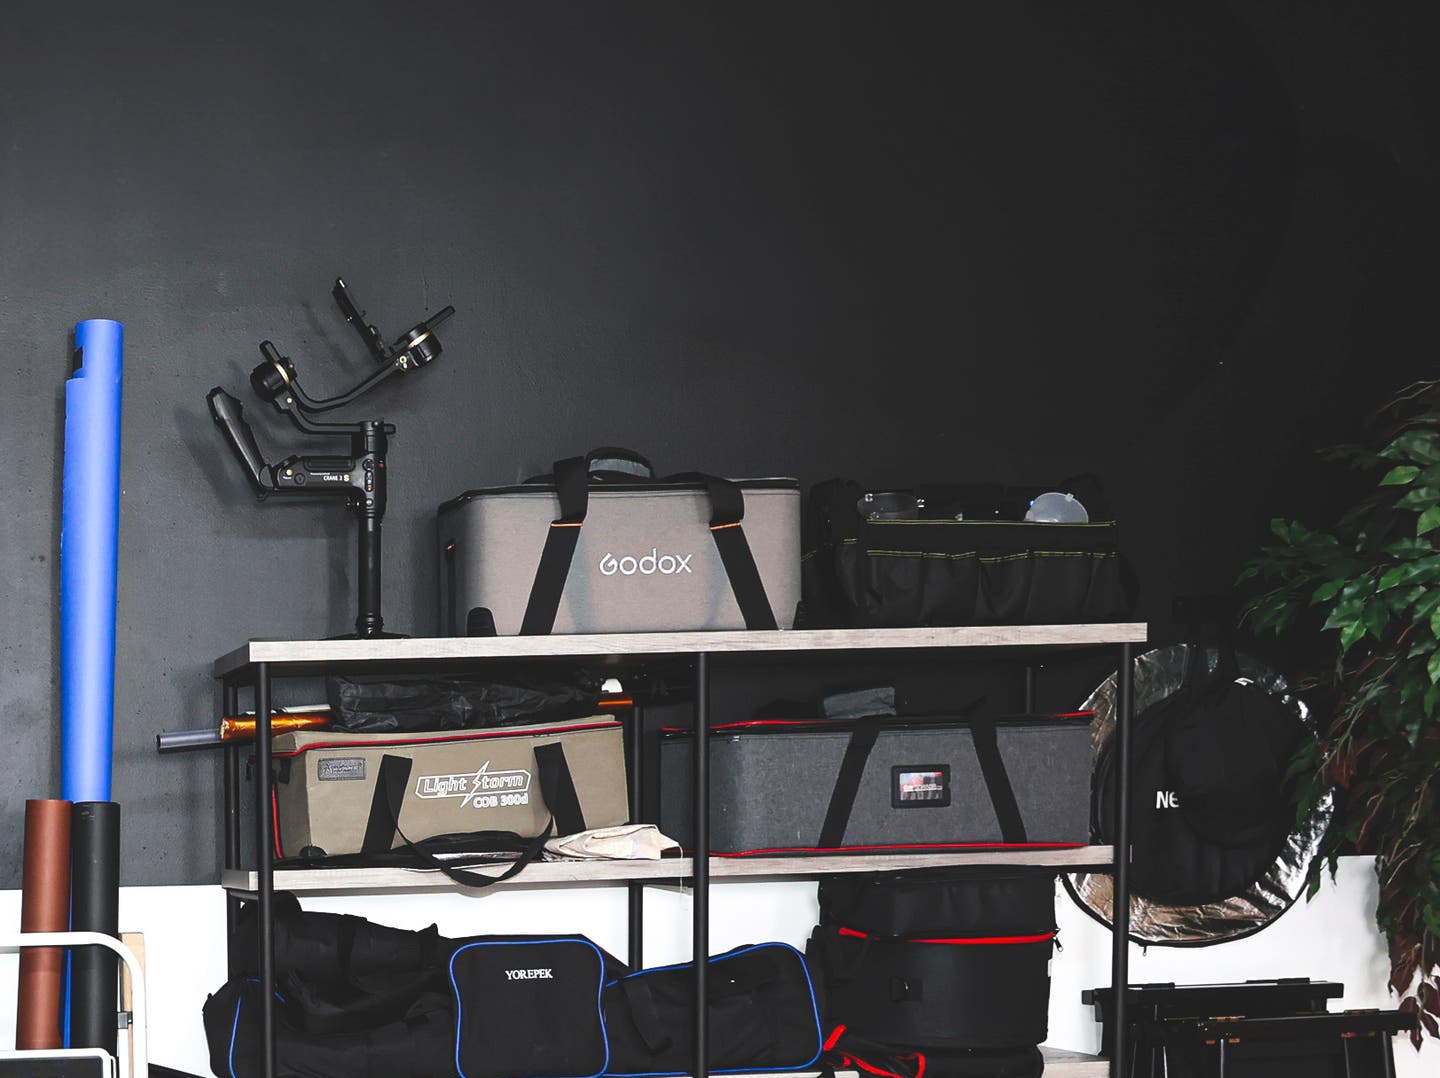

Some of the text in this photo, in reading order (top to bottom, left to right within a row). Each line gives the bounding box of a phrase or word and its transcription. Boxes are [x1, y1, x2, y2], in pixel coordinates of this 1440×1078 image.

[599, 548, 692, 576] Godox
[473, 795, 498, 808] COB
[505, 968, 553, 980] YOREPEK
